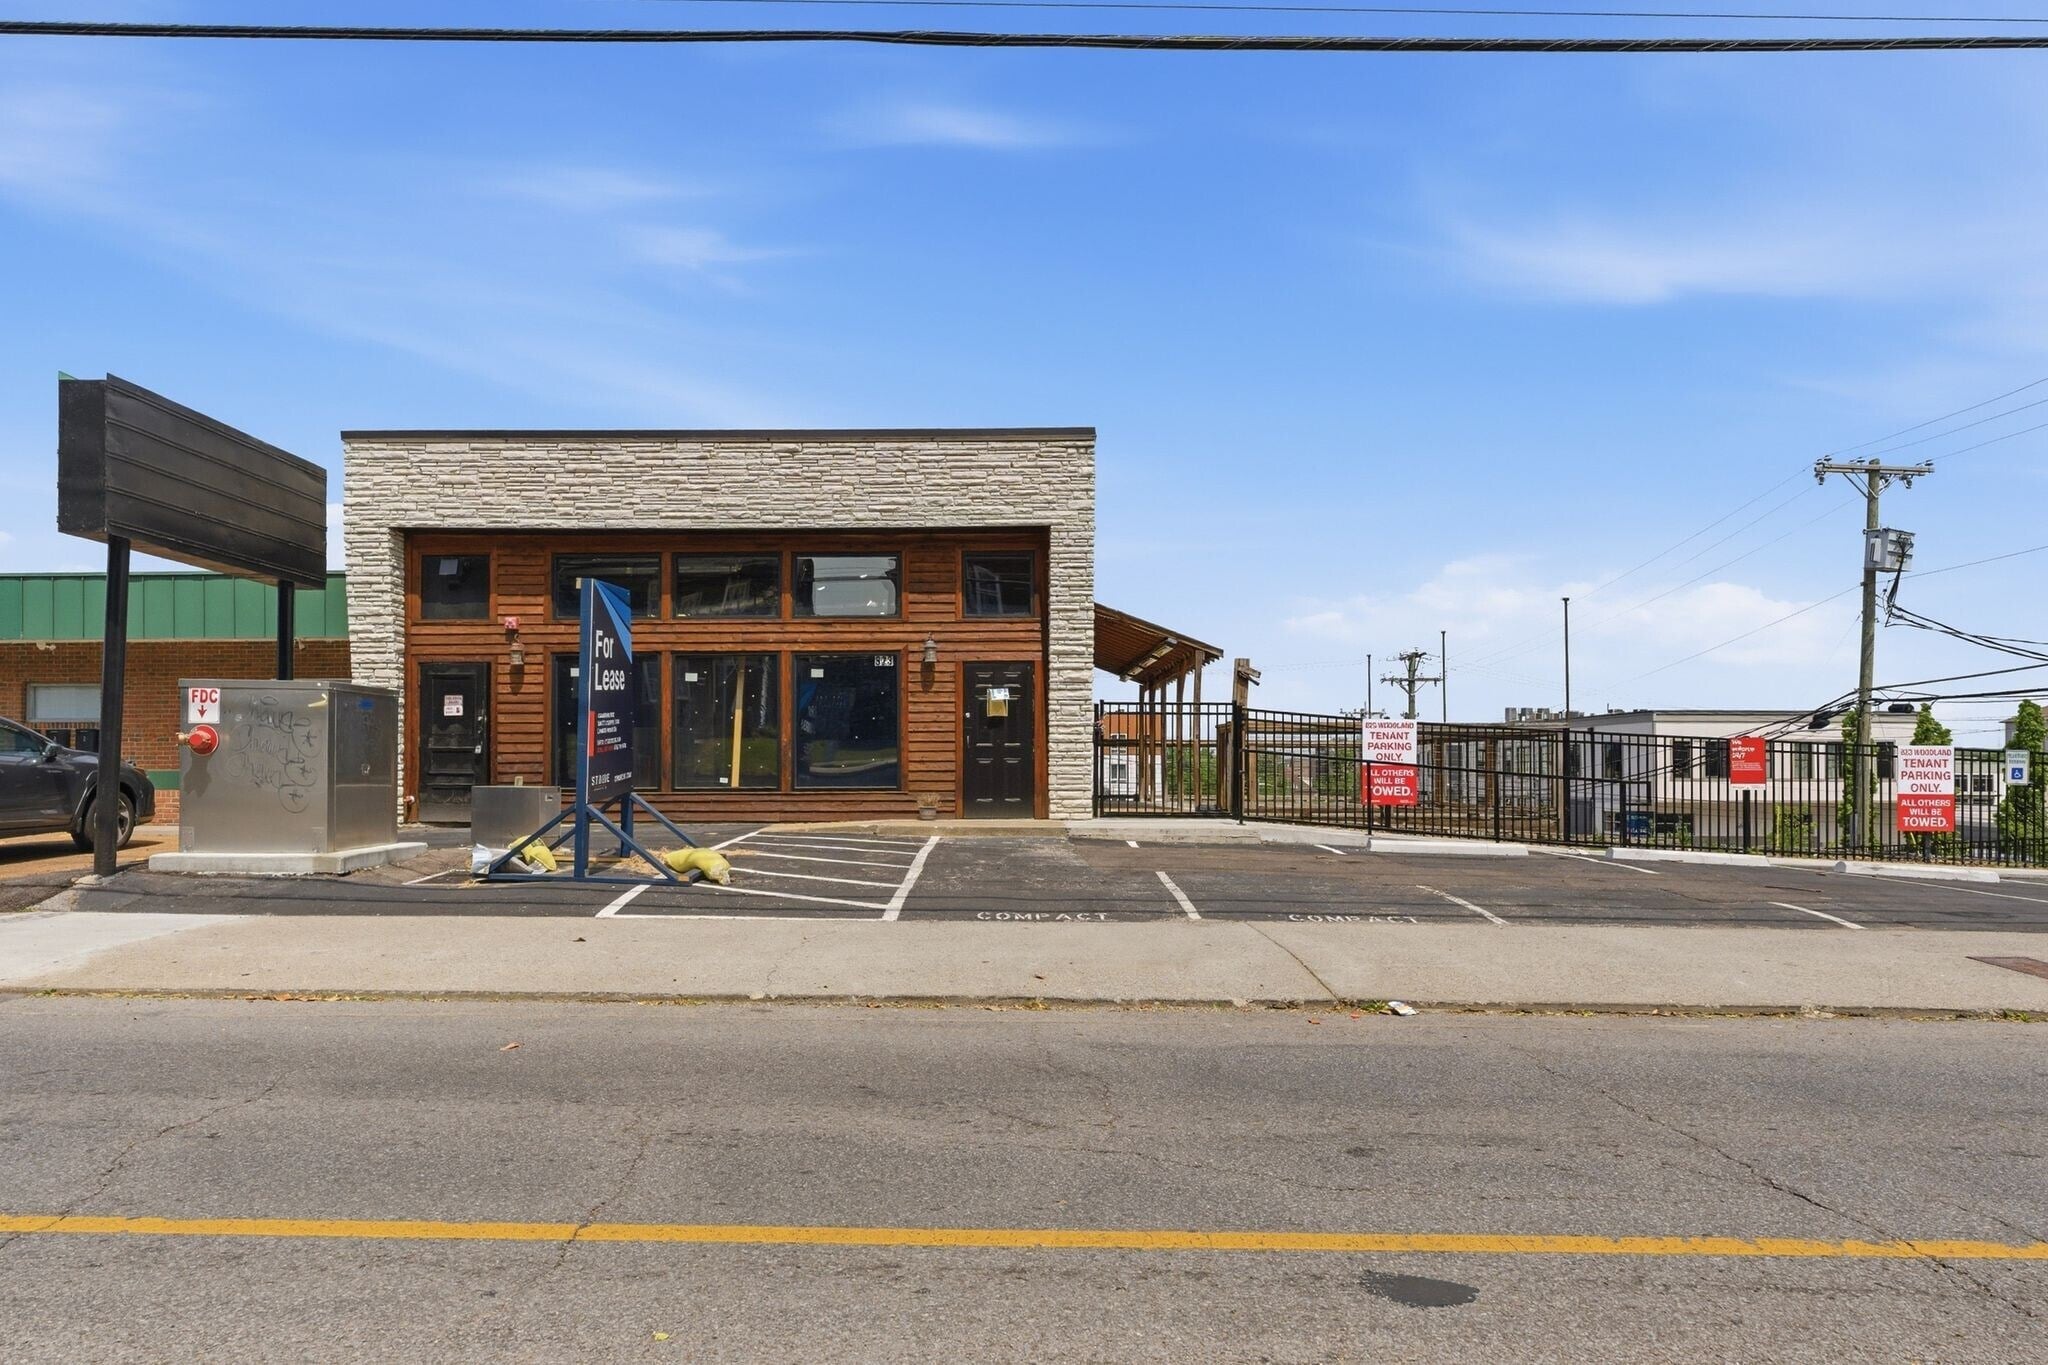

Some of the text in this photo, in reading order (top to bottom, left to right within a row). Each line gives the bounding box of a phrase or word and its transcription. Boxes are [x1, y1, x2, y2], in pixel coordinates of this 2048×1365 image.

[595, 630, 614, 658] For
[594, 663, 625, 691] Lease
[191, 689, 218, 703] FDC
[1370, 731, 1410, 740] TENANT
[1367, 742, 1412, 751] PARKING
[1375, 752, 1404, 761] ONLY.
[1914, 748, 1952, 756] WOODLAND
[1903, 759, 1950, 768] TENANT
[1381, 769, 1415, 777] OTHERS
[1900, 770, 1951, 780] PARKING
[1373, 777, 1406, 785] WILL BE
[1910, 783, 1942, 793] ONLY.
[1900, 799, 1951, 807] ALL OTHERS
[1909, 807, 1943, 816] WILL BE
[1902, 816, 1949, 827] TOWED.
[976, 911, 1109, 921] COMPACT
[1288, 914, 1419, 924] COMPACT
